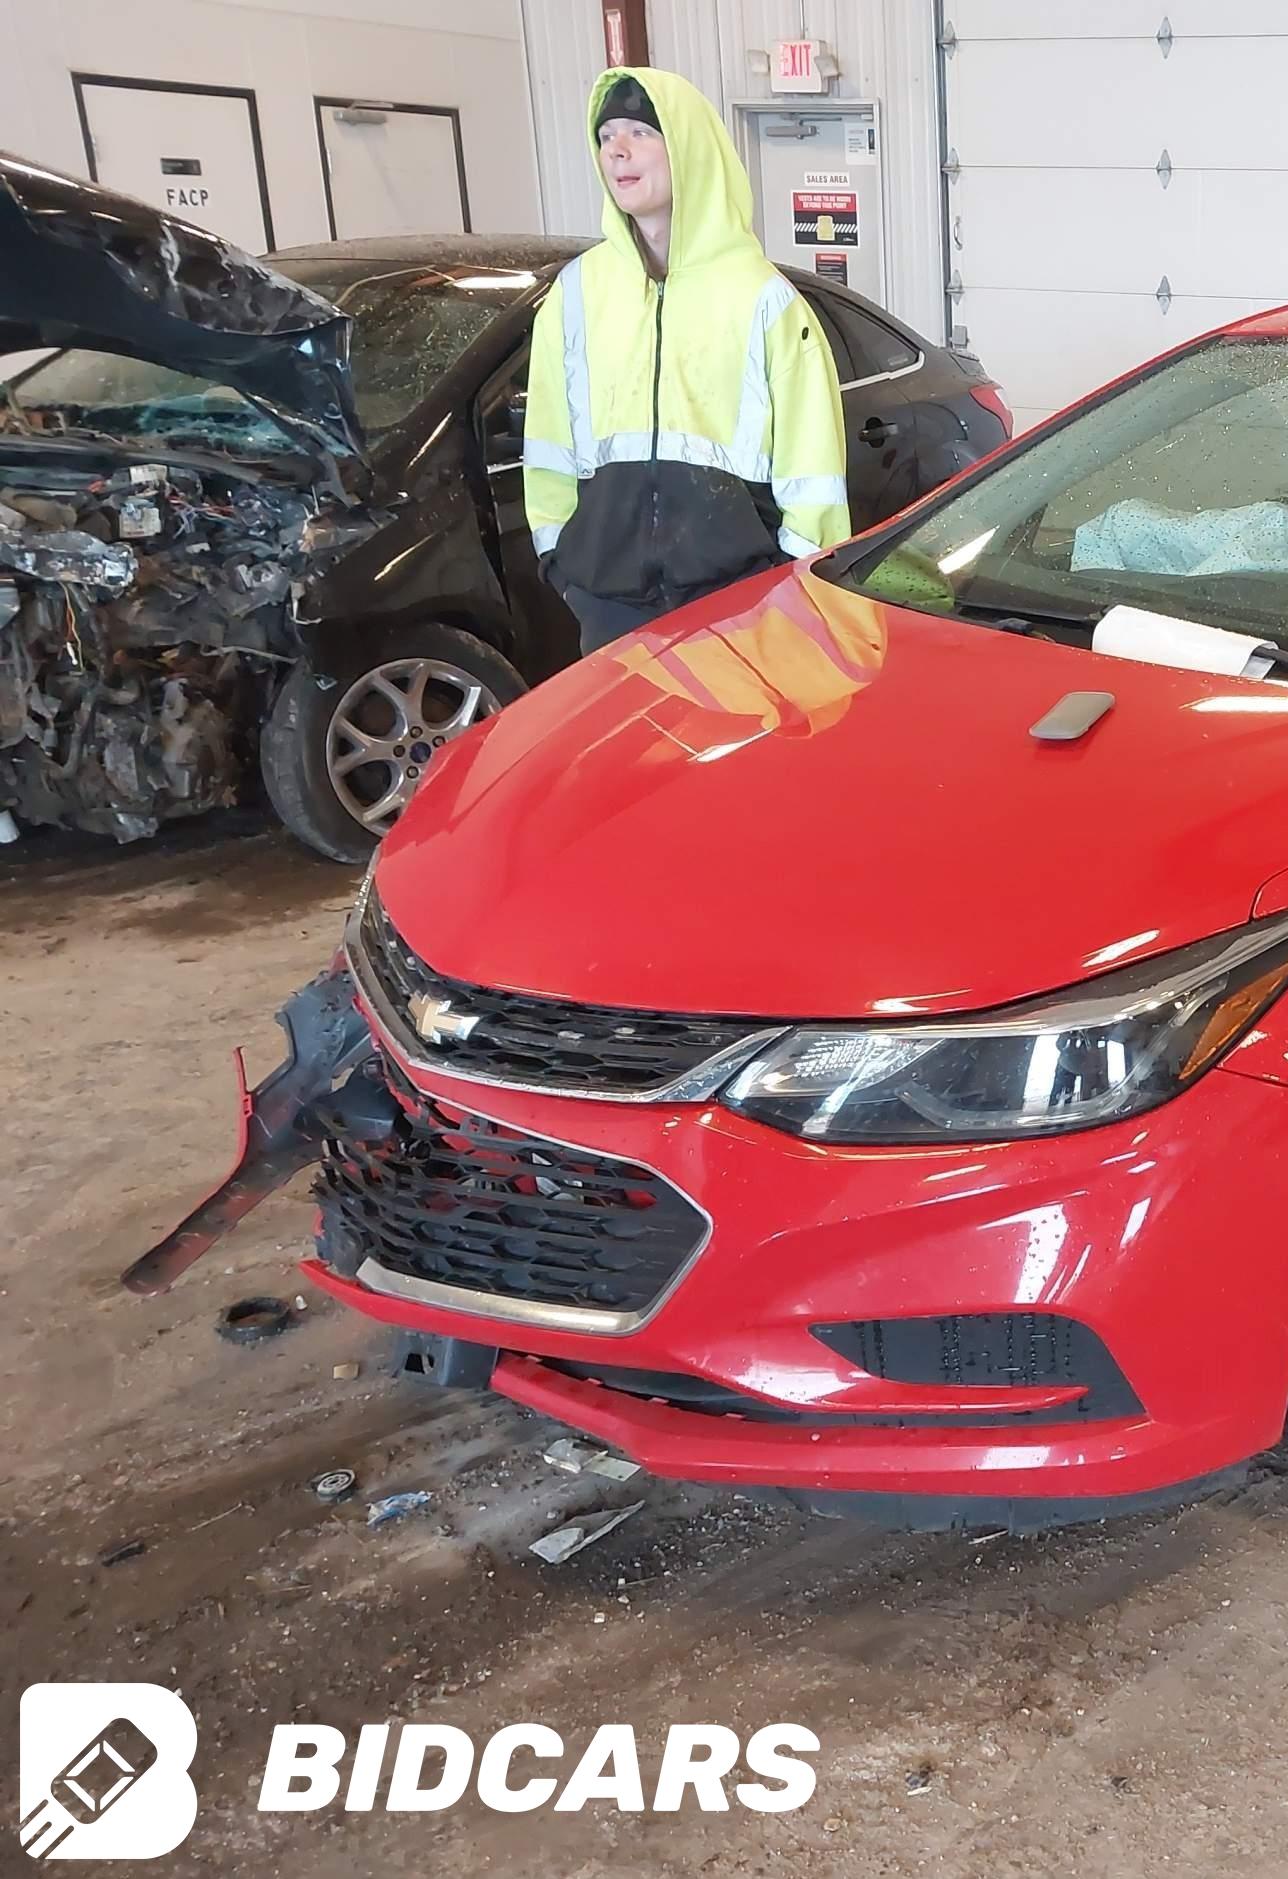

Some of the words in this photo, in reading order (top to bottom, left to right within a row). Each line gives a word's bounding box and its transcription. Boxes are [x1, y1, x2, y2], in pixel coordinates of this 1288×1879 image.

[782, 44, 811, 76] EXIT
[806, 175, 828, 184] SALES
[830, 175, 848, 184] AREA
[166, 188, 209, 206] FACP
